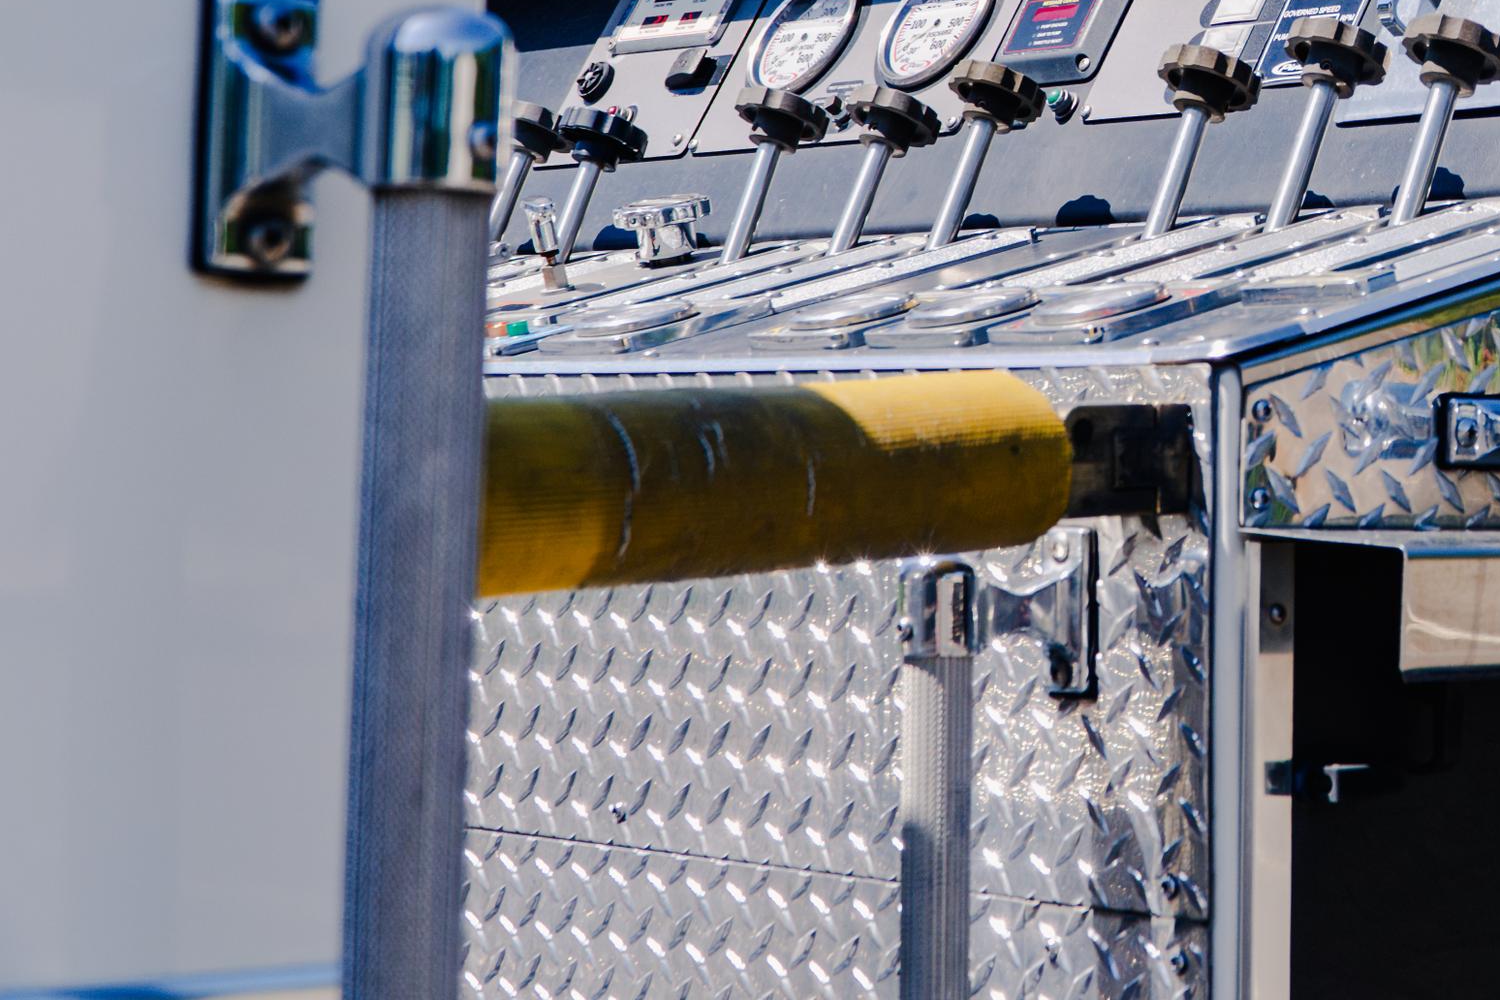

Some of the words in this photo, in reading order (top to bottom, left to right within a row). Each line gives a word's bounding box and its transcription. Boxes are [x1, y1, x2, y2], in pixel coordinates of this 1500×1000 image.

[1282, 6, 1319, 18] GOVERNED
[1319, 4, 1342, 14] SPEED
[947, 16, 965, 28] 500
[1340, 13, 1356, 21] RPM
[910, 18, 927, 30] 100
[780, 32, 795, 43] 100
[815, 32, 832, 43] 500
[929, 39, 947, 50] 600
[796, 53, 814, 64] 600
